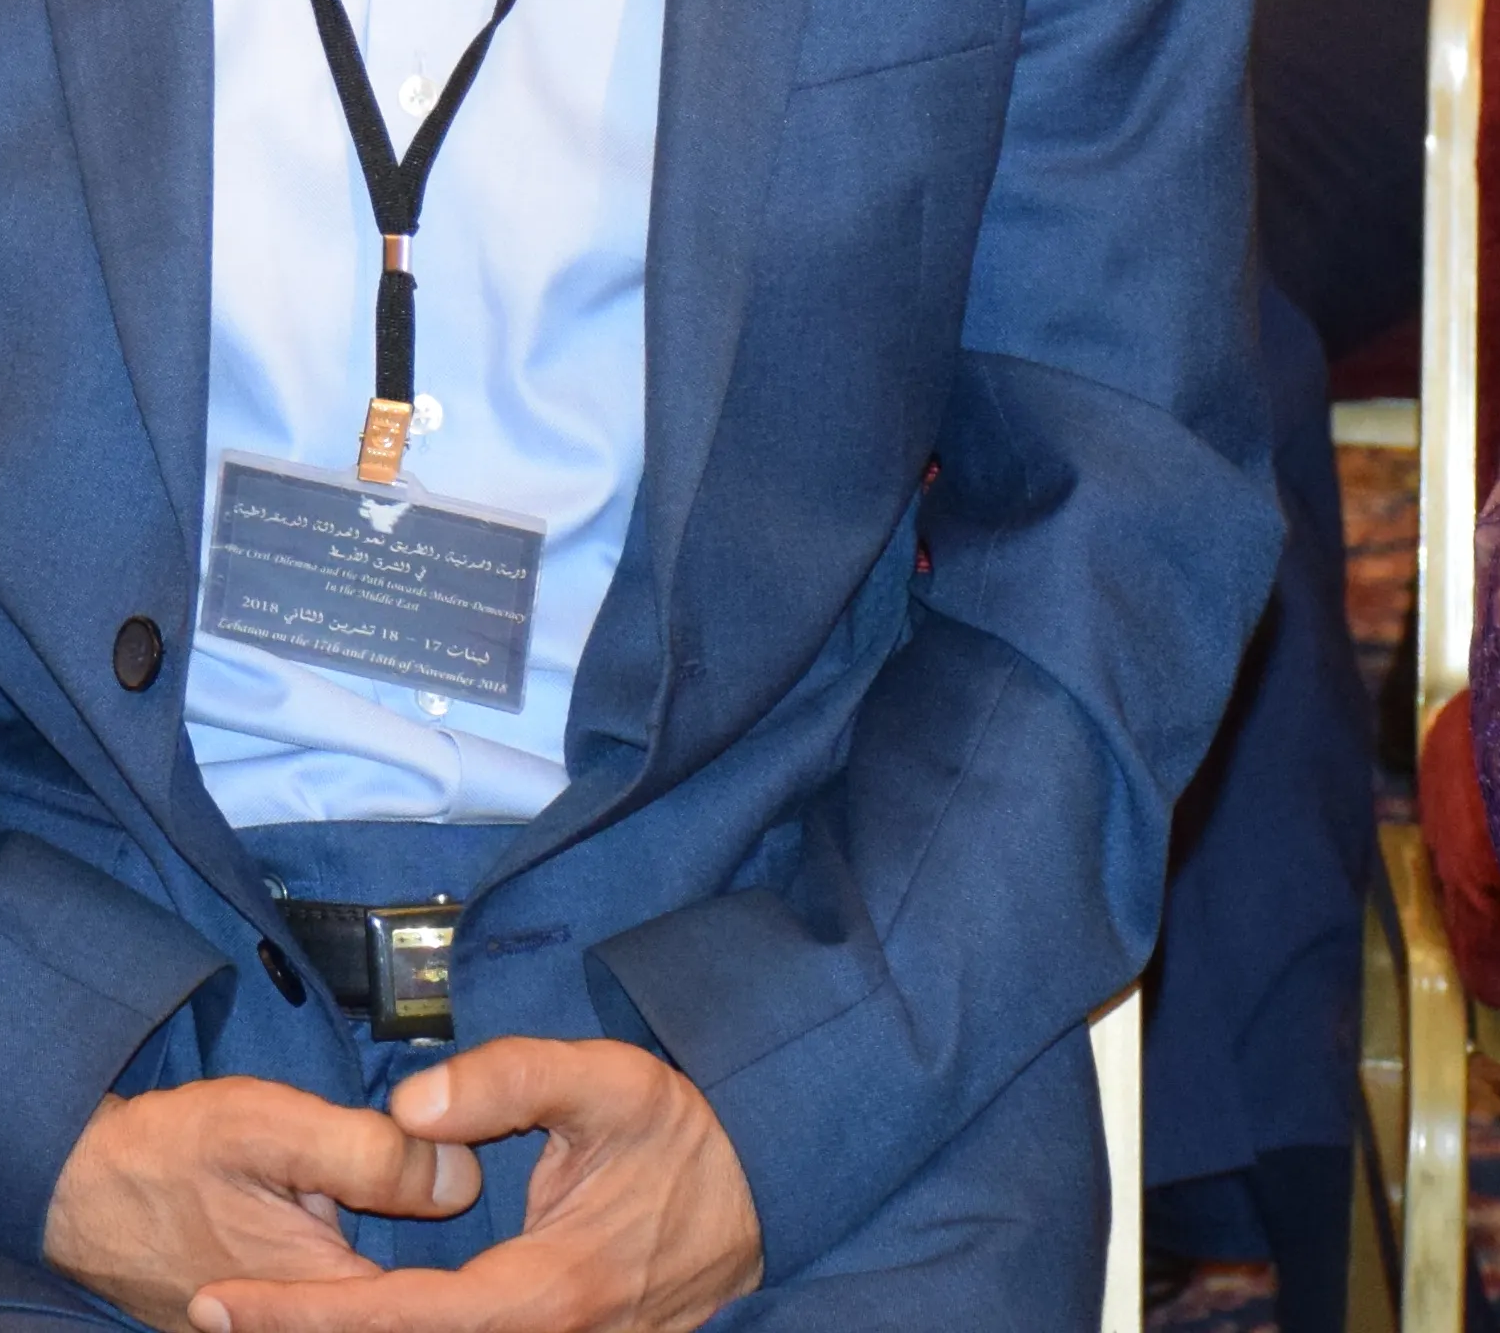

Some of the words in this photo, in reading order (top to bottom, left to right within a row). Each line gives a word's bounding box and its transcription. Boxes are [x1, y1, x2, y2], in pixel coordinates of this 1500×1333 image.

[319, 566, 340, 577] and
[372, 557, 411, 574] الشرق
[414, 565, 427, 583] في
[242, 595, 279, 614] 2018
[283, 607, 324, 625] الثاني
[328, 619, 376, 636] تشرين
[382, 628, 399, 642] 18
[217, 617, 269, 638] Lebanon
[271, 632, 287, 642] on
[290, 633, 310, 647] the
[313, 639, 341, 653] 17th
[341, 648, 367, 660] and
[369, 652, 396, 667] 18th
[398, 659, 416, 673] of
[414, 663, 475, 685] November
[424, 638, 442, 652] 17
[446, 645, 490, 666] لبنان
